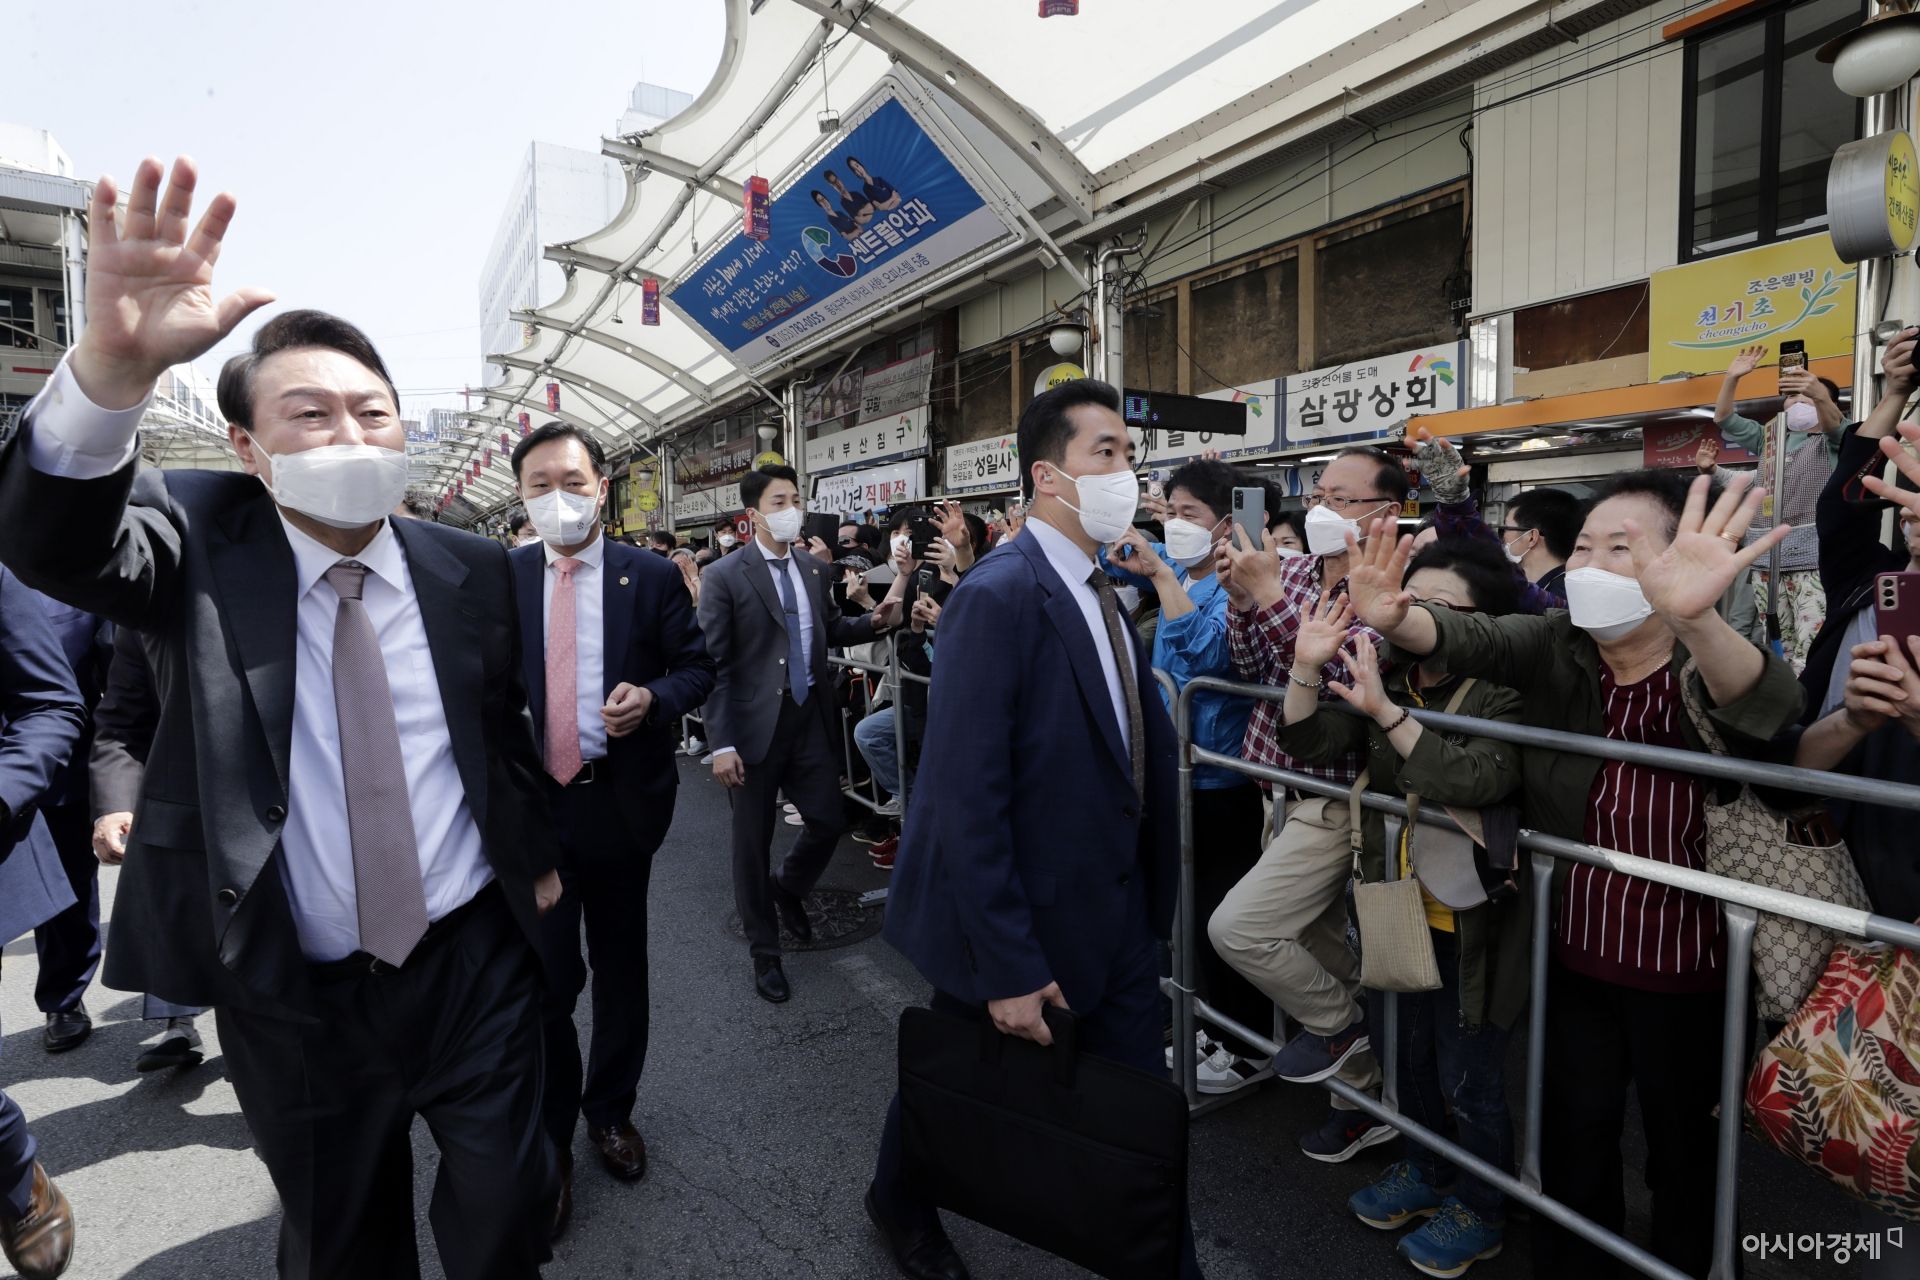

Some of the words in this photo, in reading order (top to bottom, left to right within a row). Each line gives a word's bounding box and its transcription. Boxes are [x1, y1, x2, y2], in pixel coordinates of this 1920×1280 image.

[848, 198, 937, 264] 센트럴안과
[710, 298, 739, 325] 백내장
[753, 270, 785, 294] 안과는
[780, 250, 807, 274] 어디?
[825, 296, 851, 317] 동대구역
[850, 286, 871, 306] 네거리
[870, 278, 887, 293] 서한
[883, 259, 917, 284] 오피스텔
[911, 251, 931, 270] 5층
[1747, 269, 1814, 295] 조은웰빙
[1697, 297, 1774, 326] 천기초
[1699, 321, 1767, 340] cheongicho
[1301, 371, 1352, 389] 각종건어물
[1356, 366, 1378, 380] 도매
[1299, 374, 1437, 428] 삼광상회
[974, 451, 1012, 478] 성일사
